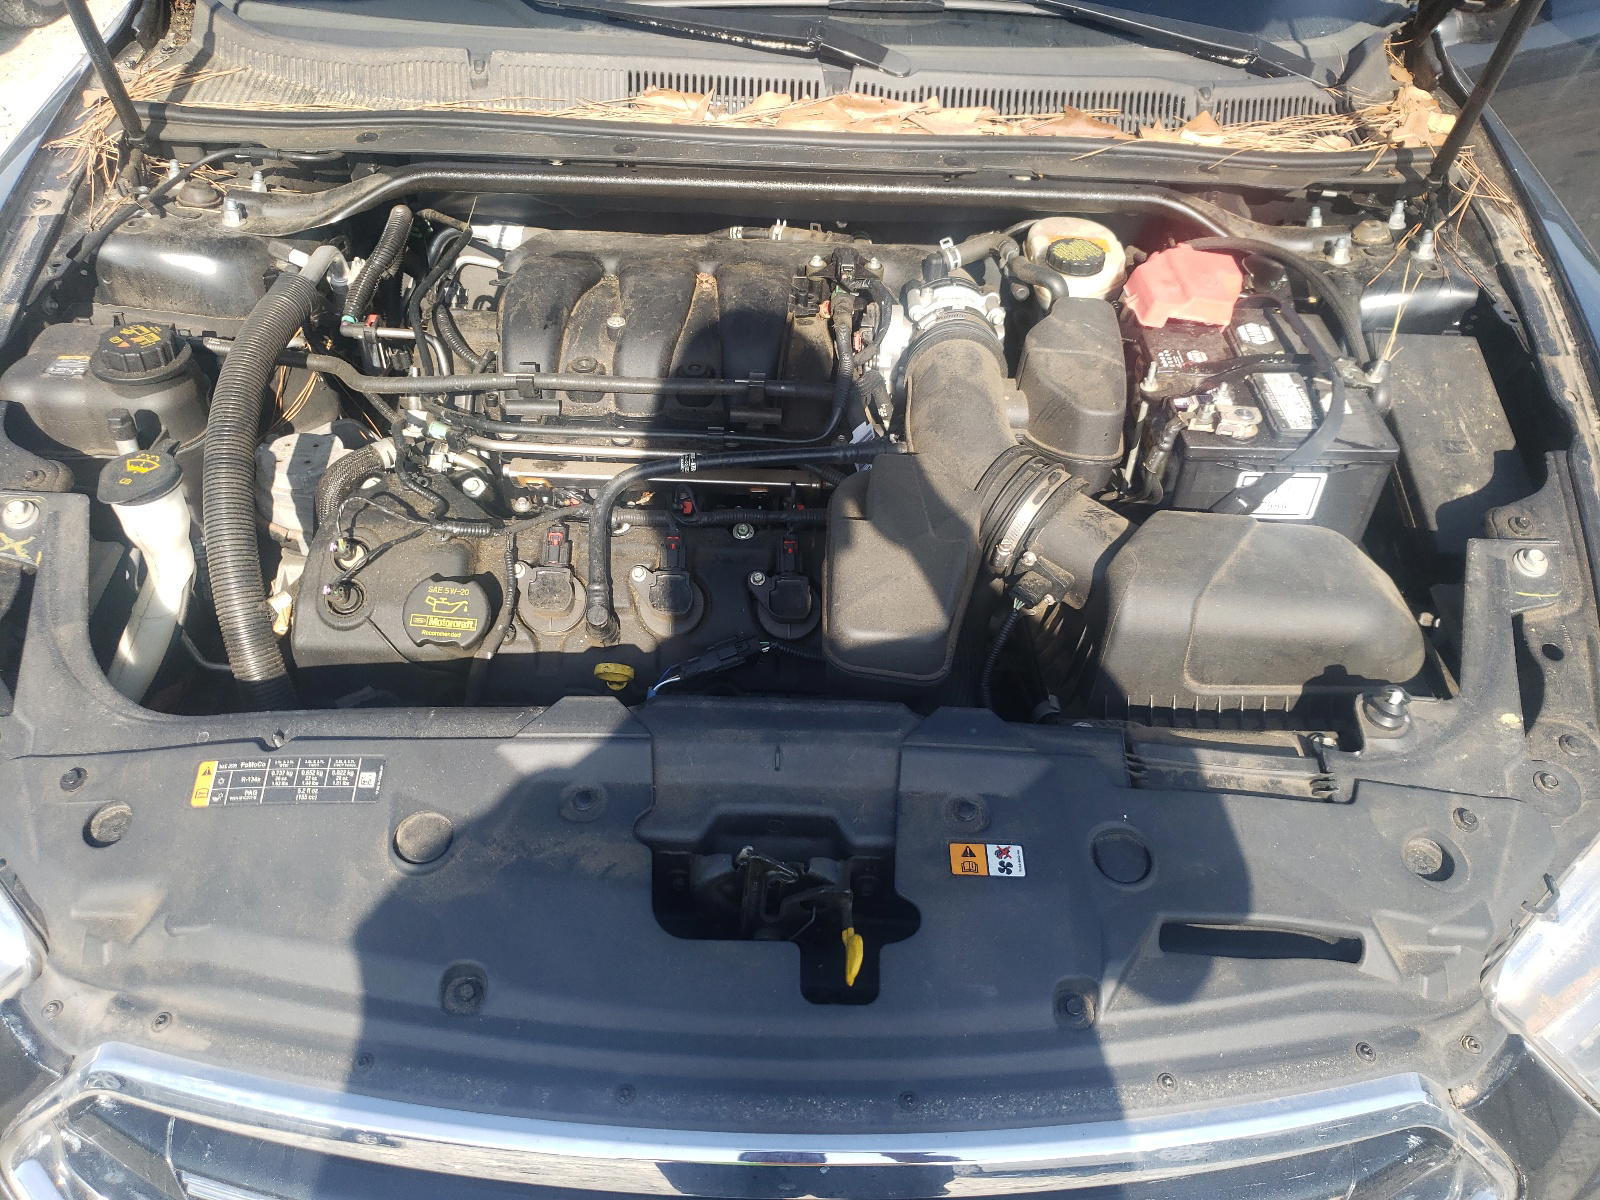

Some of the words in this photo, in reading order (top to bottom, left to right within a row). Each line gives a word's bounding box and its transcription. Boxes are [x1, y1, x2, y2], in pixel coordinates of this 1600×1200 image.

[427, 586, 443, 594] SAE
[444, 587, 470, 596] 5W-20
[428, 616, 475, 630] Motorcraft
[347, 769, 355, 777] kg
